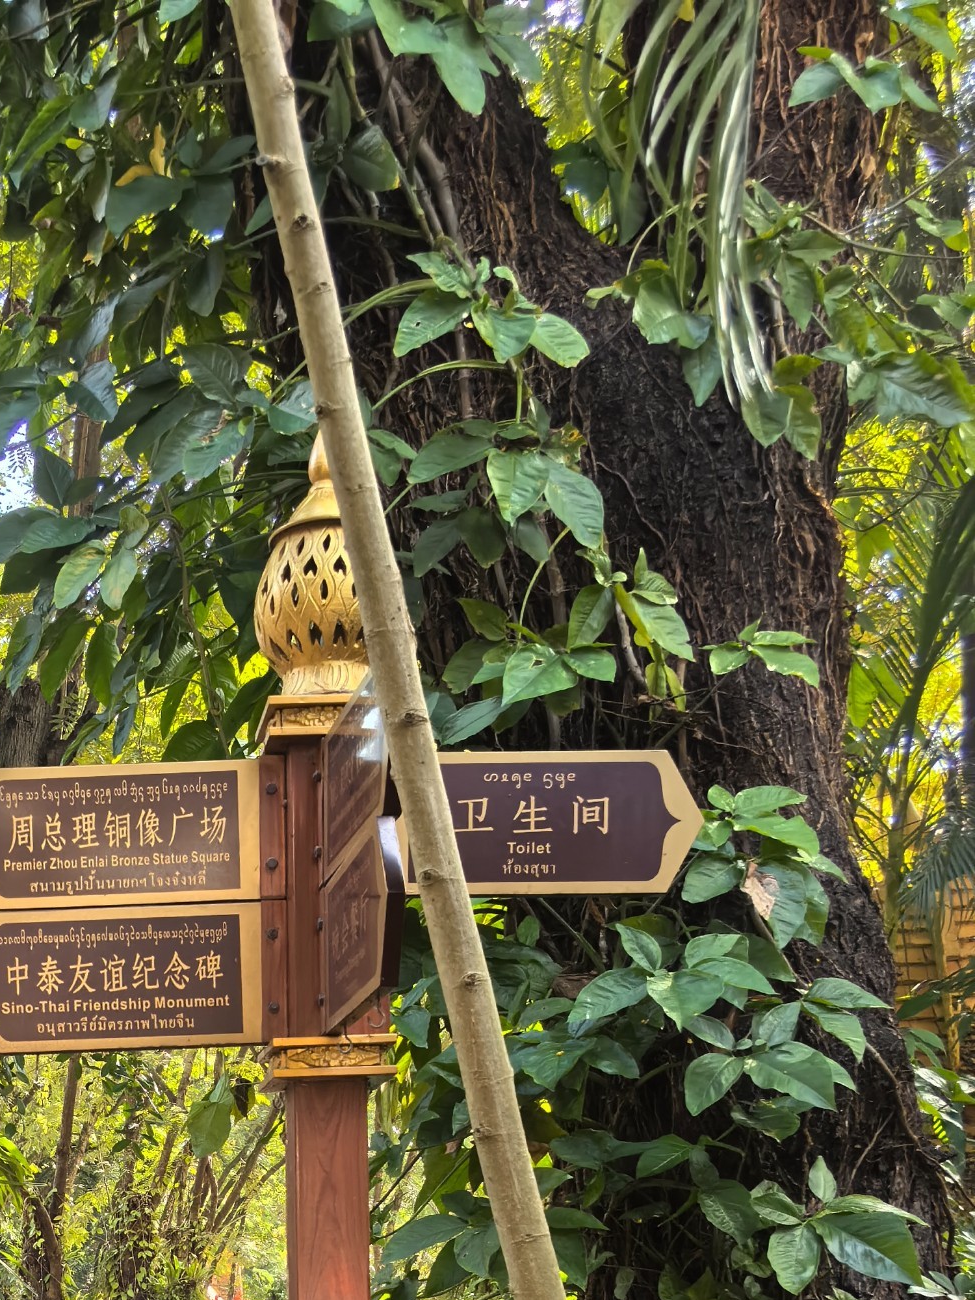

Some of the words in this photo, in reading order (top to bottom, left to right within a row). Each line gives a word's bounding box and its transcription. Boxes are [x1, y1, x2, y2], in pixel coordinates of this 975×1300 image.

[454, 795, 610, 835] 卫生间
[8, 804, 227, 854] 周总理铜像广场
[507, 841, 552, 854] Toilet
[4, 858, 47, 872] Premier
[50, 857, 77, 870] Zhou
[81, 855, 108, 868] Enlai
[111, 854, 150, 867] Bronze
[153, 852, 189, 866] Statue
[192, 850, 230, 866] Square
[502, 858, 556, 877] ห้องสุขา
[6, 949, 224, 996] 中泰友谊纪念碑
[1, 999, 70, 1015] Sino-Thai
[74, 997, 151, 1012] Friendship
[155, 994, 230, 1010] Monument
[37, 1014, 195, 1038] อนุสาวรีย์มิตรภาพไทยจีน
